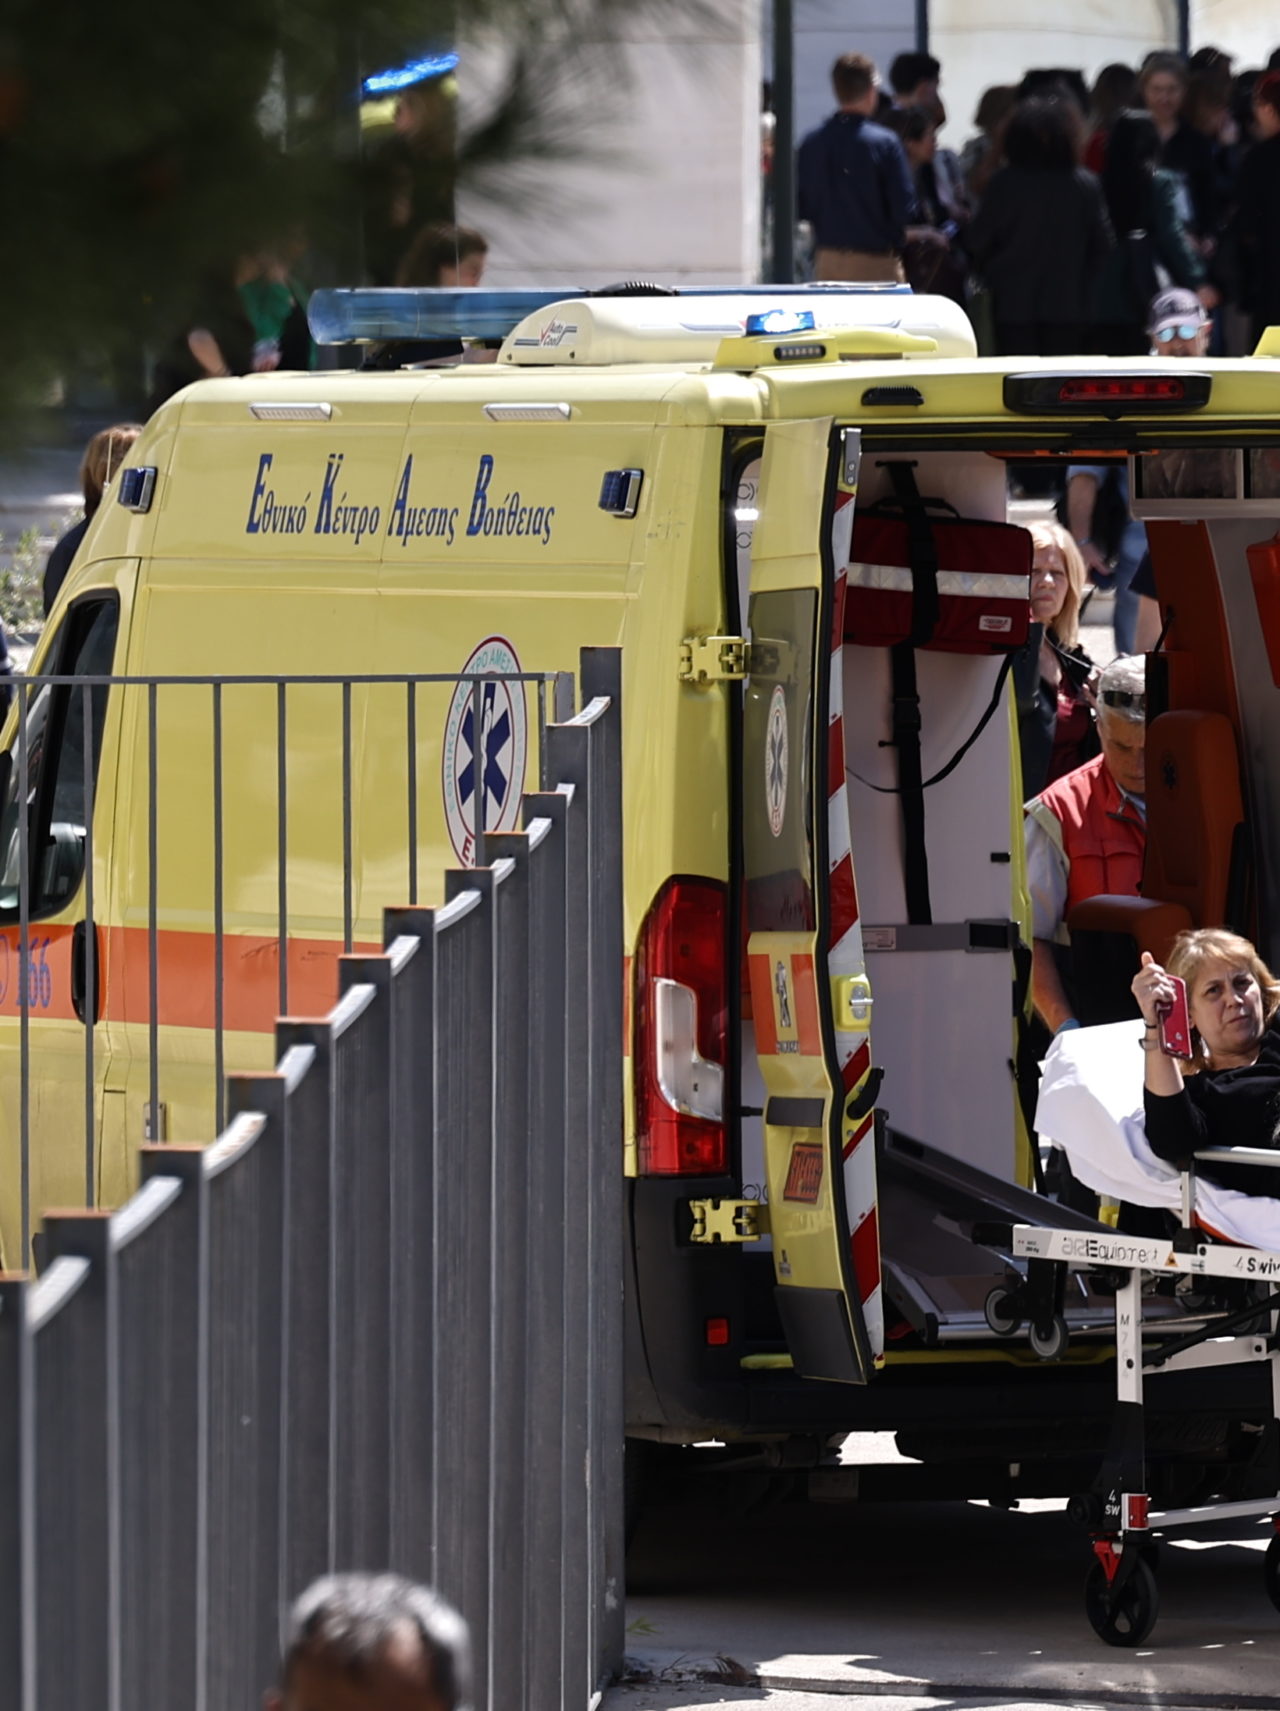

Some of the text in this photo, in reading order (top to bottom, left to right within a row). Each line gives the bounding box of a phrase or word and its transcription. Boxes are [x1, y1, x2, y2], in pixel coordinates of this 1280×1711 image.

[246, 453, 555, 547] Εθνικό Κέντρο Αμεσης Βοήθειας
[1108, 1489, 1116, 1503] 4
[1105, 1504, 1121, 1516] SW
